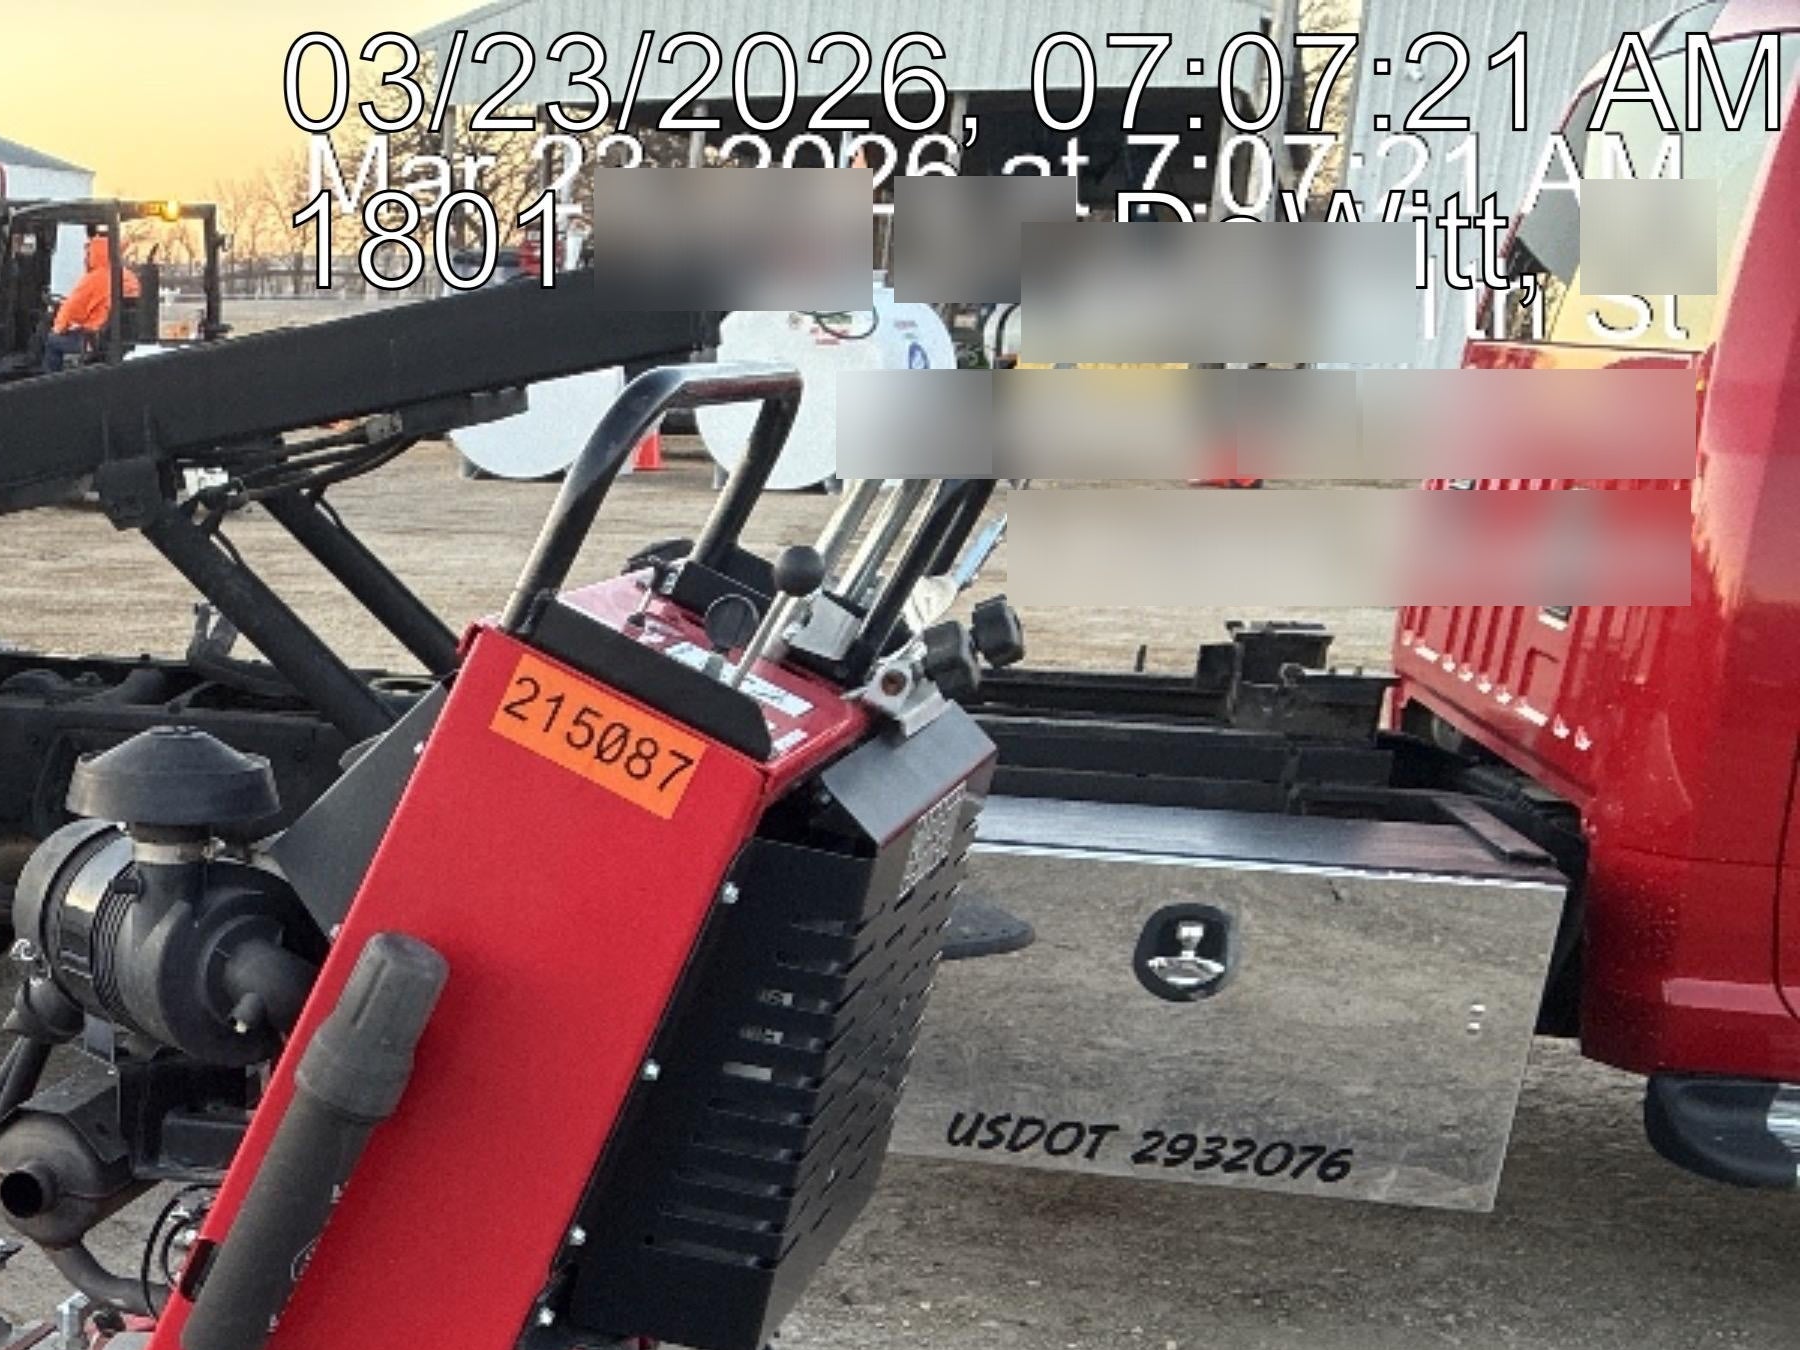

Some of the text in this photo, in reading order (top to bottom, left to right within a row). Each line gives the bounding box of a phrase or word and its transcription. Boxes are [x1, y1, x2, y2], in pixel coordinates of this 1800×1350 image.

[501, 677, 695, 793] 215087
[947, 1111, 1355, 1183] USDOT 2932076
